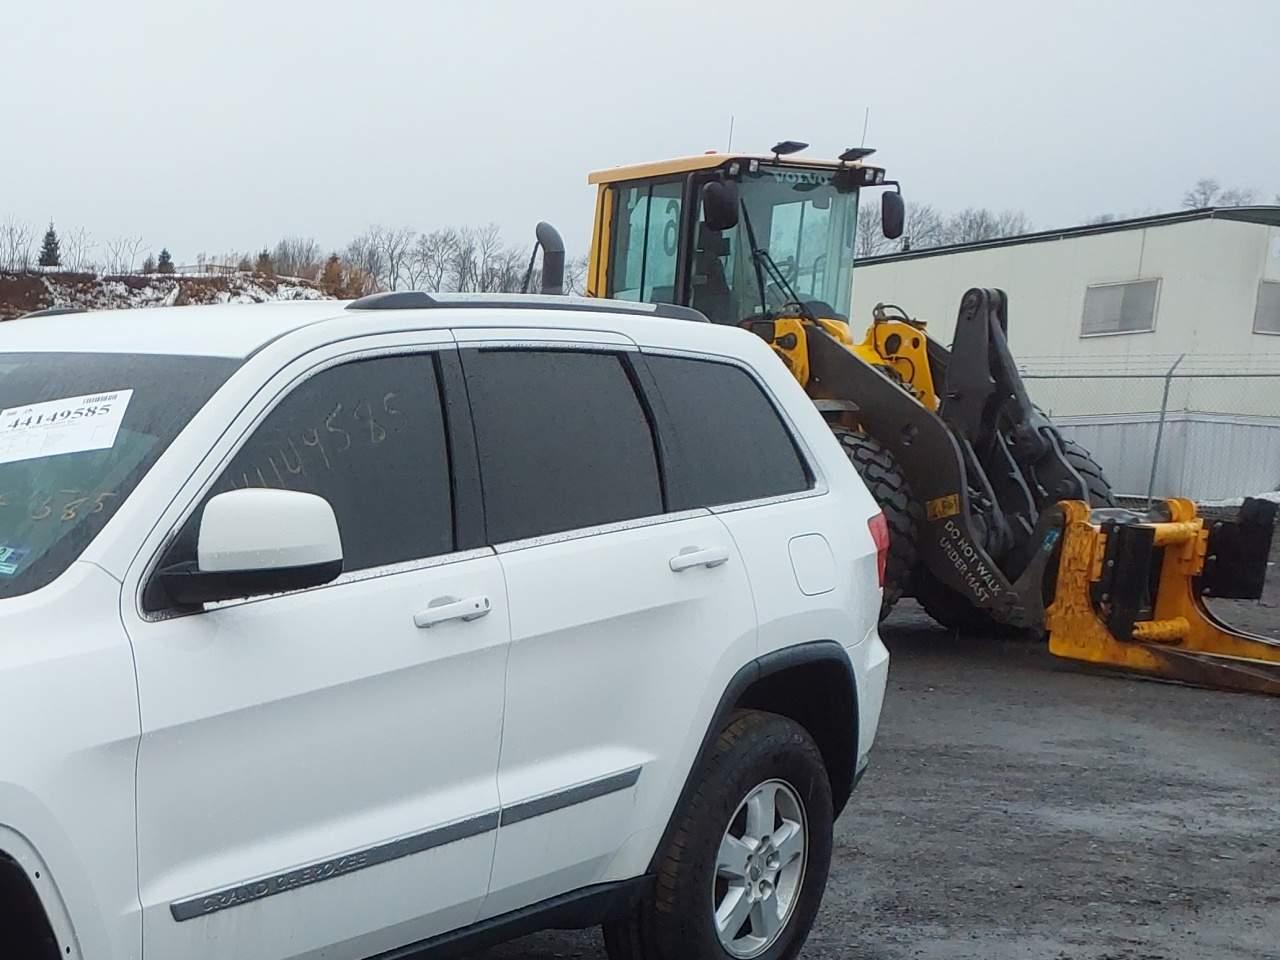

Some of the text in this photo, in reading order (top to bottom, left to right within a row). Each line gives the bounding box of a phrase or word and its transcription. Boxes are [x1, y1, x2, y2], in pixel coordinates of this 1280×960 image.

[774, 171, 830, 187] VOLVO
[7, 404, 112, 429] 44149585
[939, 537, 990, 602] UNDER MAST
[944, 520, 1001, 597] DO NOT WALK
[203, 852, 369, 912] GRAND CHEROKEE
